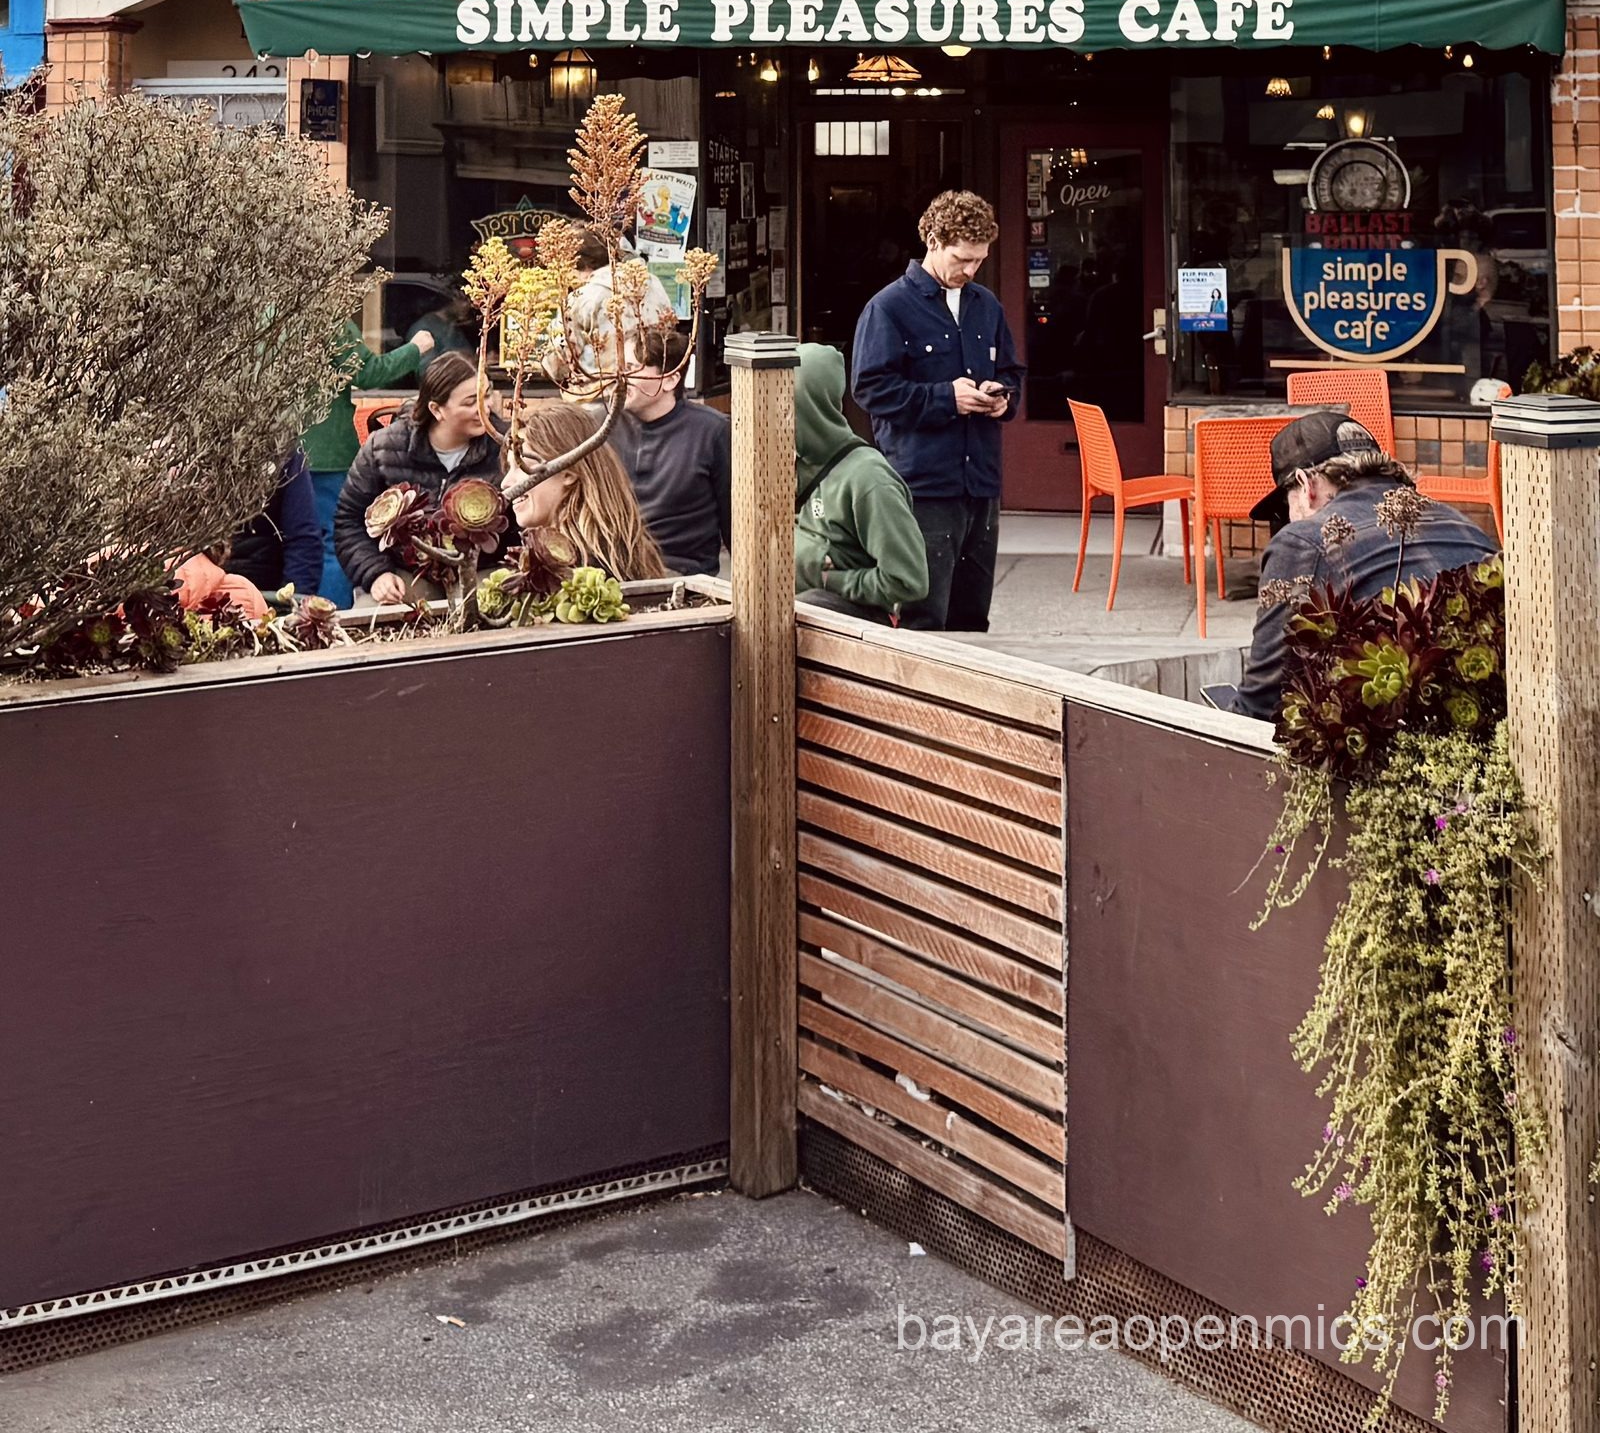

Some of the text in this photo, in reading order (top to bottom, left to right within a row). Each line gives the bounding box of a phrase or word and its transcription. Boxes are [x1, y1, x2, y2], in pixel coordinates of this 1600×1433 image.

[655, 174, 675, 182] CAN'T
[1060, 184, 1111, 206] Open
[1305, 212, 1412, 234] BALLAST
[1324, 235, 1402, 249] POINT
[1322, 252, 1408, 290] simple
[1303, 281, 1427, 319] pleasures
[1334, 311, 1390, 348] cafe
